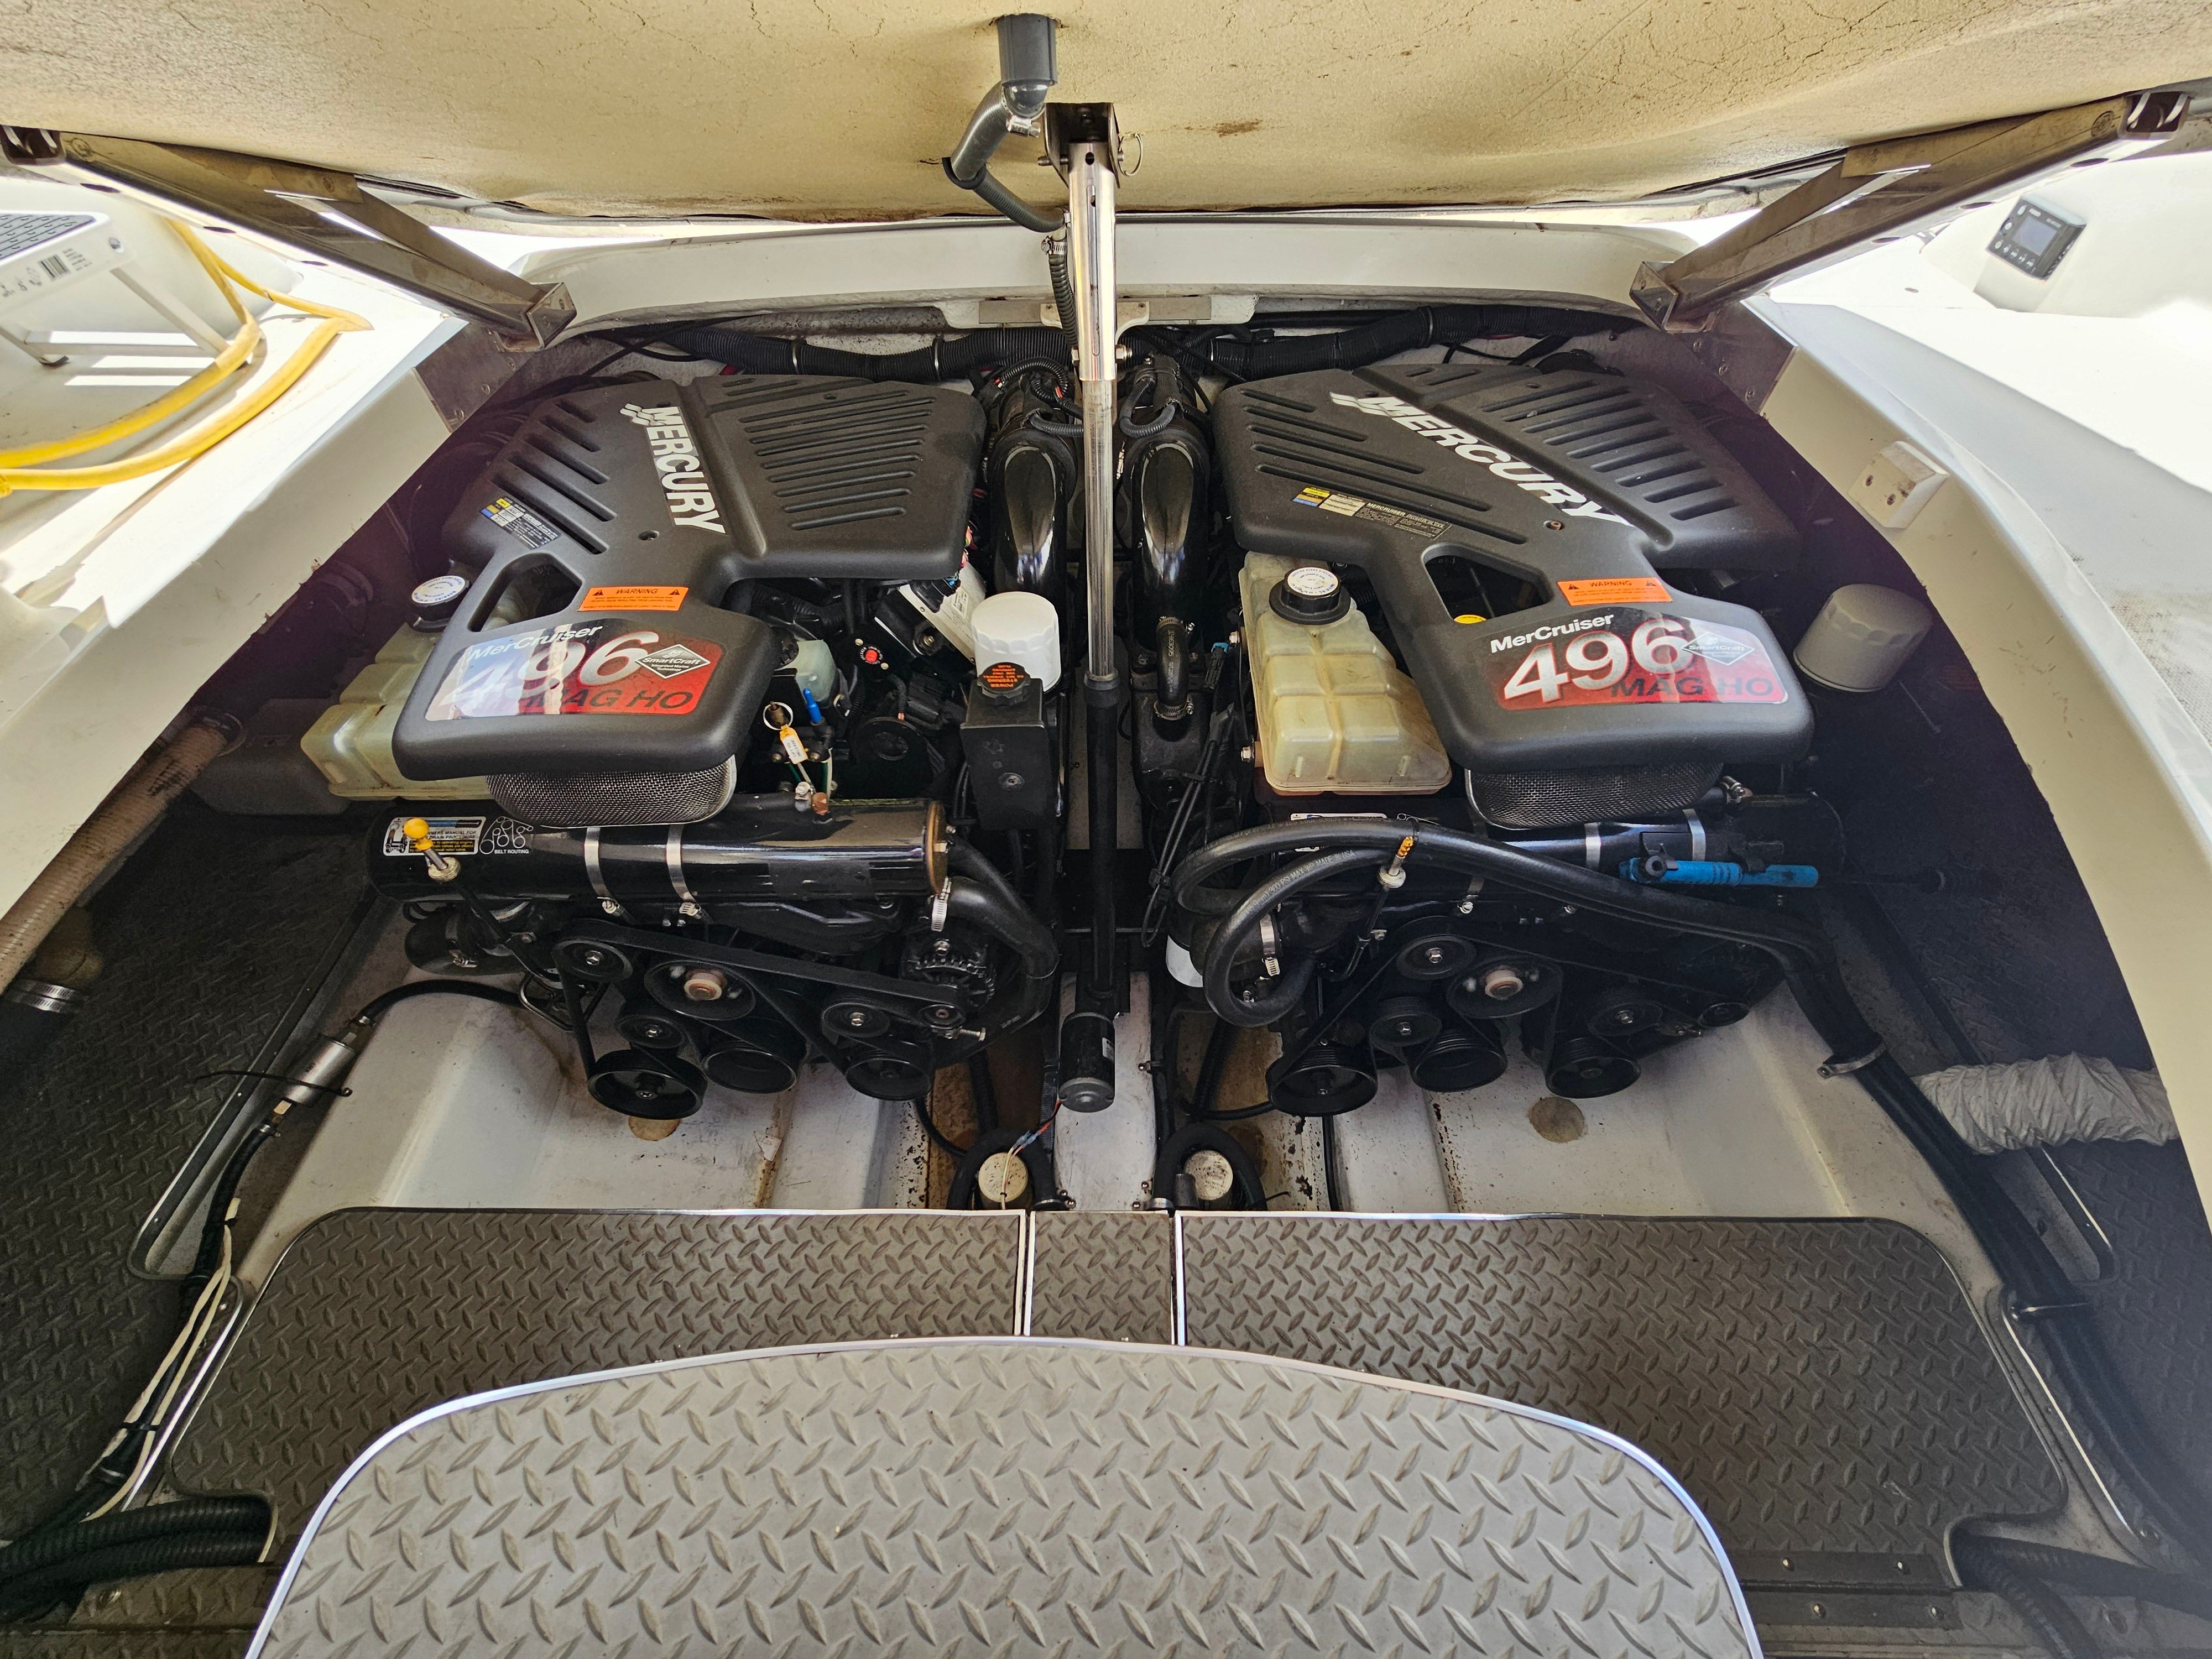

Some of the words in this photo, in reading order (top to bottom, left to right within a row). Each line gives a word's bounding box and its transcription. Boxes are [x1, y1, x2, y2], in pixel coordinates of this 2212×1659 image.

[641, 406, 726, 534] MERCURY
[1358, 397, 1632, 527] MERCURY
[1366, 502, 1406, 517] MERCRUISER
[468, 625, 603, 662] MerCruiser
[1490, 614, 1614, 654] MerCruiser
[1504, 618, 1695, 703] 496
[524, 688, 618, 709] MAG
[627, 690, 694, 709] HO
[1610, 678, 1703, 697] MAG
[1717, 677, 1774, 697] HO
[1268, 883, 1281, 894] 300
[1280, 877, 1291, 886] PSI
[1291, 869, 1306, 880] MAX
[1315, 855, 1333, 867] MADE
[1342, 849, 1355, 859] USA
